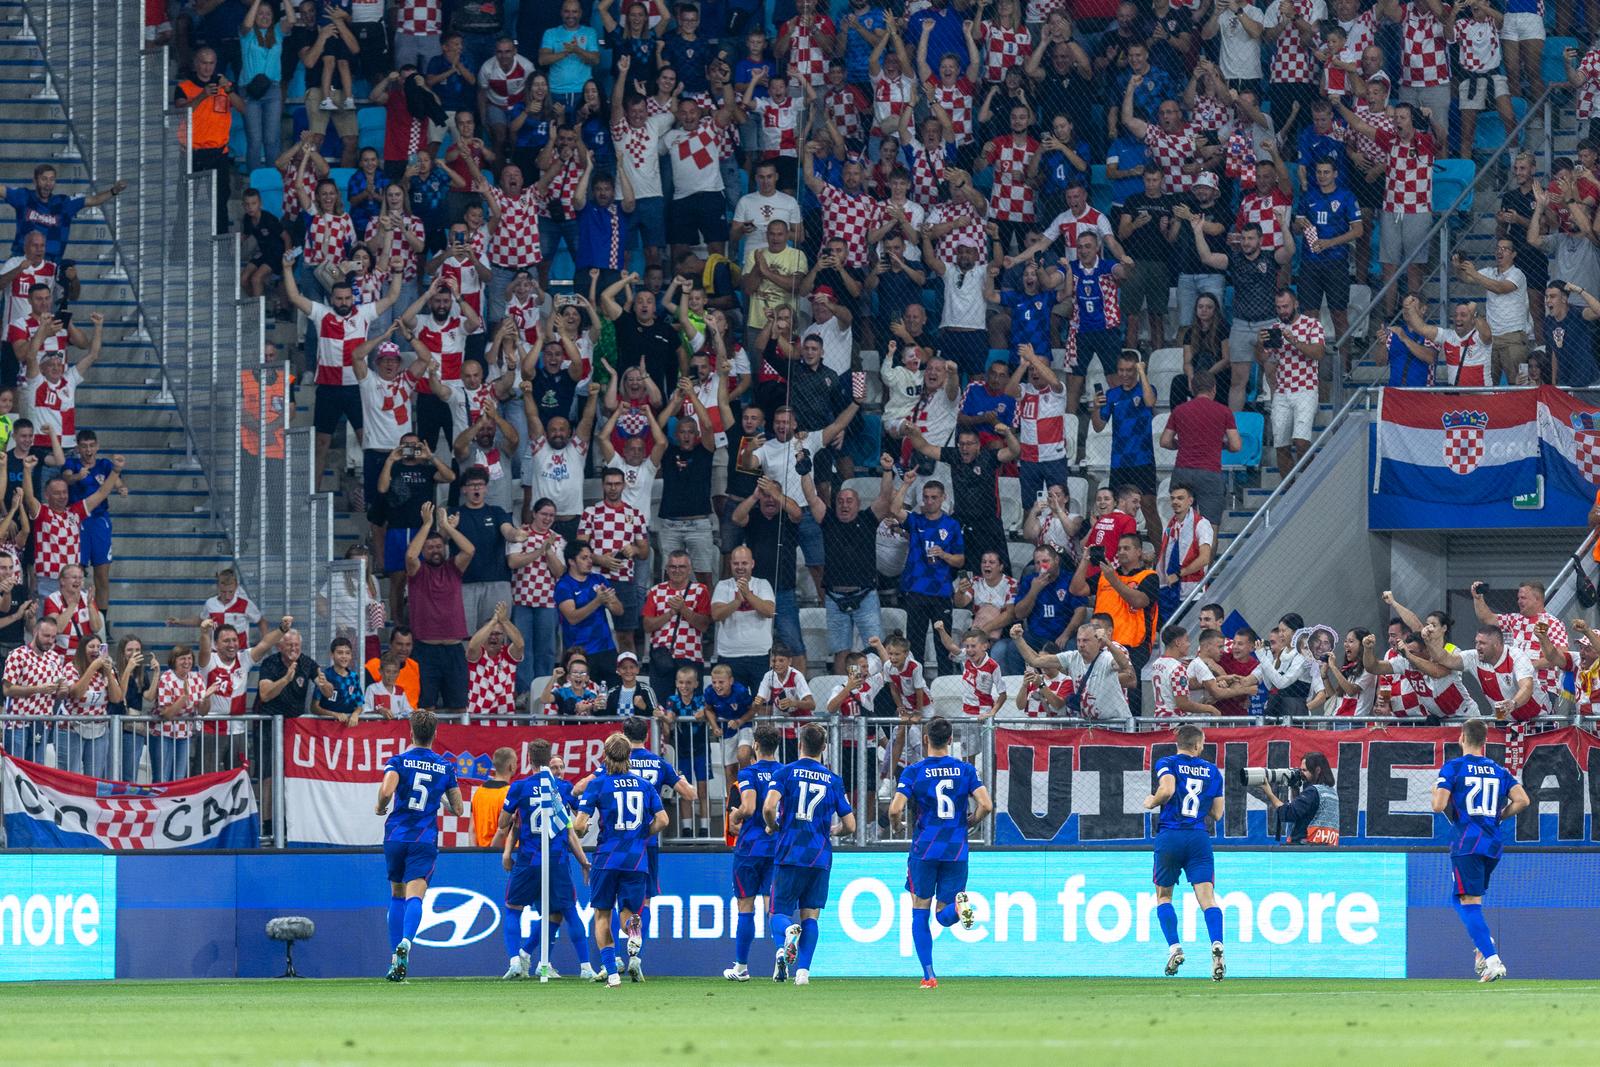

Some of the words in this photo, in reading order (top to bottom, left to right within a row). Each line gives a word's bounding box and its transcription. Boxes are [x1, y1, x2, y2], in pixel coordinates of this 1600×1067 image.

[1317, 211, 1328, 225] 10
[19, 282, 31, 295] 10
[1085, 300, 1095, 313] 6
[1024, 309, 1031, 321] 4
[45, 391, 58, 405] 10
[1022, 401, 1036, 418] 10
[1043, 604, 1055, 618] 10
[91, 692, 102, 704] 17
[1467, 764, 1495, 775] PJACA
[613, 779, 639, 788] SOSA
[408, 771, 432, 811] 5
[1181, 777, 1203, 818] 8
[1465, 776, 1500, 818] 20
[795, 780, 827, 822] 17
[935, 779, 956, 820] 6
[613, 791, 644, 831] 19
[1057, 873, 1163, 944] for
[1183, 891, 1380, 945] more
